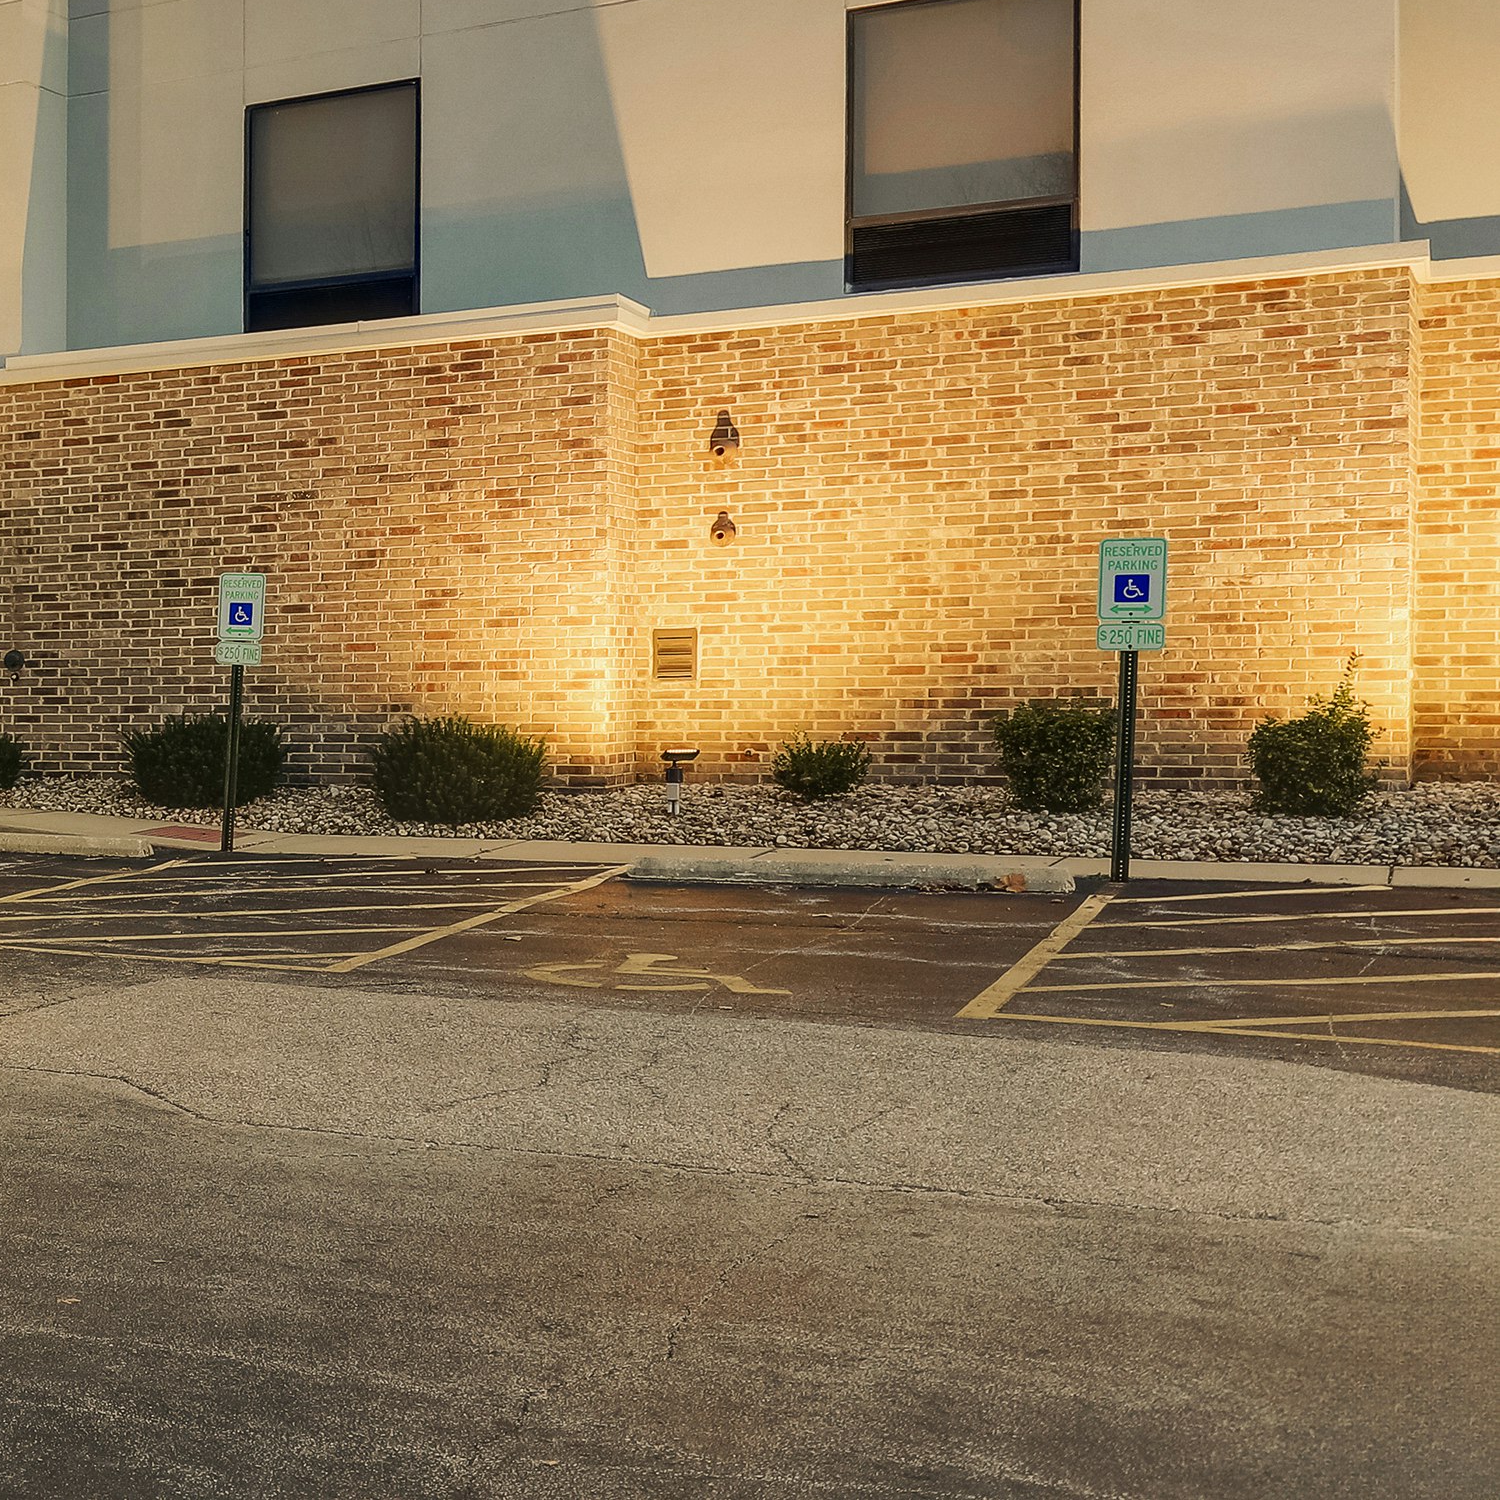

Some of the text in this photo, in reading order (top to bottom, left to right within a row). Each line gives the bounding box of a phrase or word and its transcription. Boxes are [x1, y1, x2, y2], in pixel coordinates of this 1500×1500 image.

[1104, 545, 1163, 557] RESERVED
[1108, 560, 1158, 571] PARKING
[223, 579, 263, 589] RESERVED
[225, 590, 259, 600] PARKING
[1137, 629, 1162, 645] FINE
[242, 647, 259, 661] FINE
